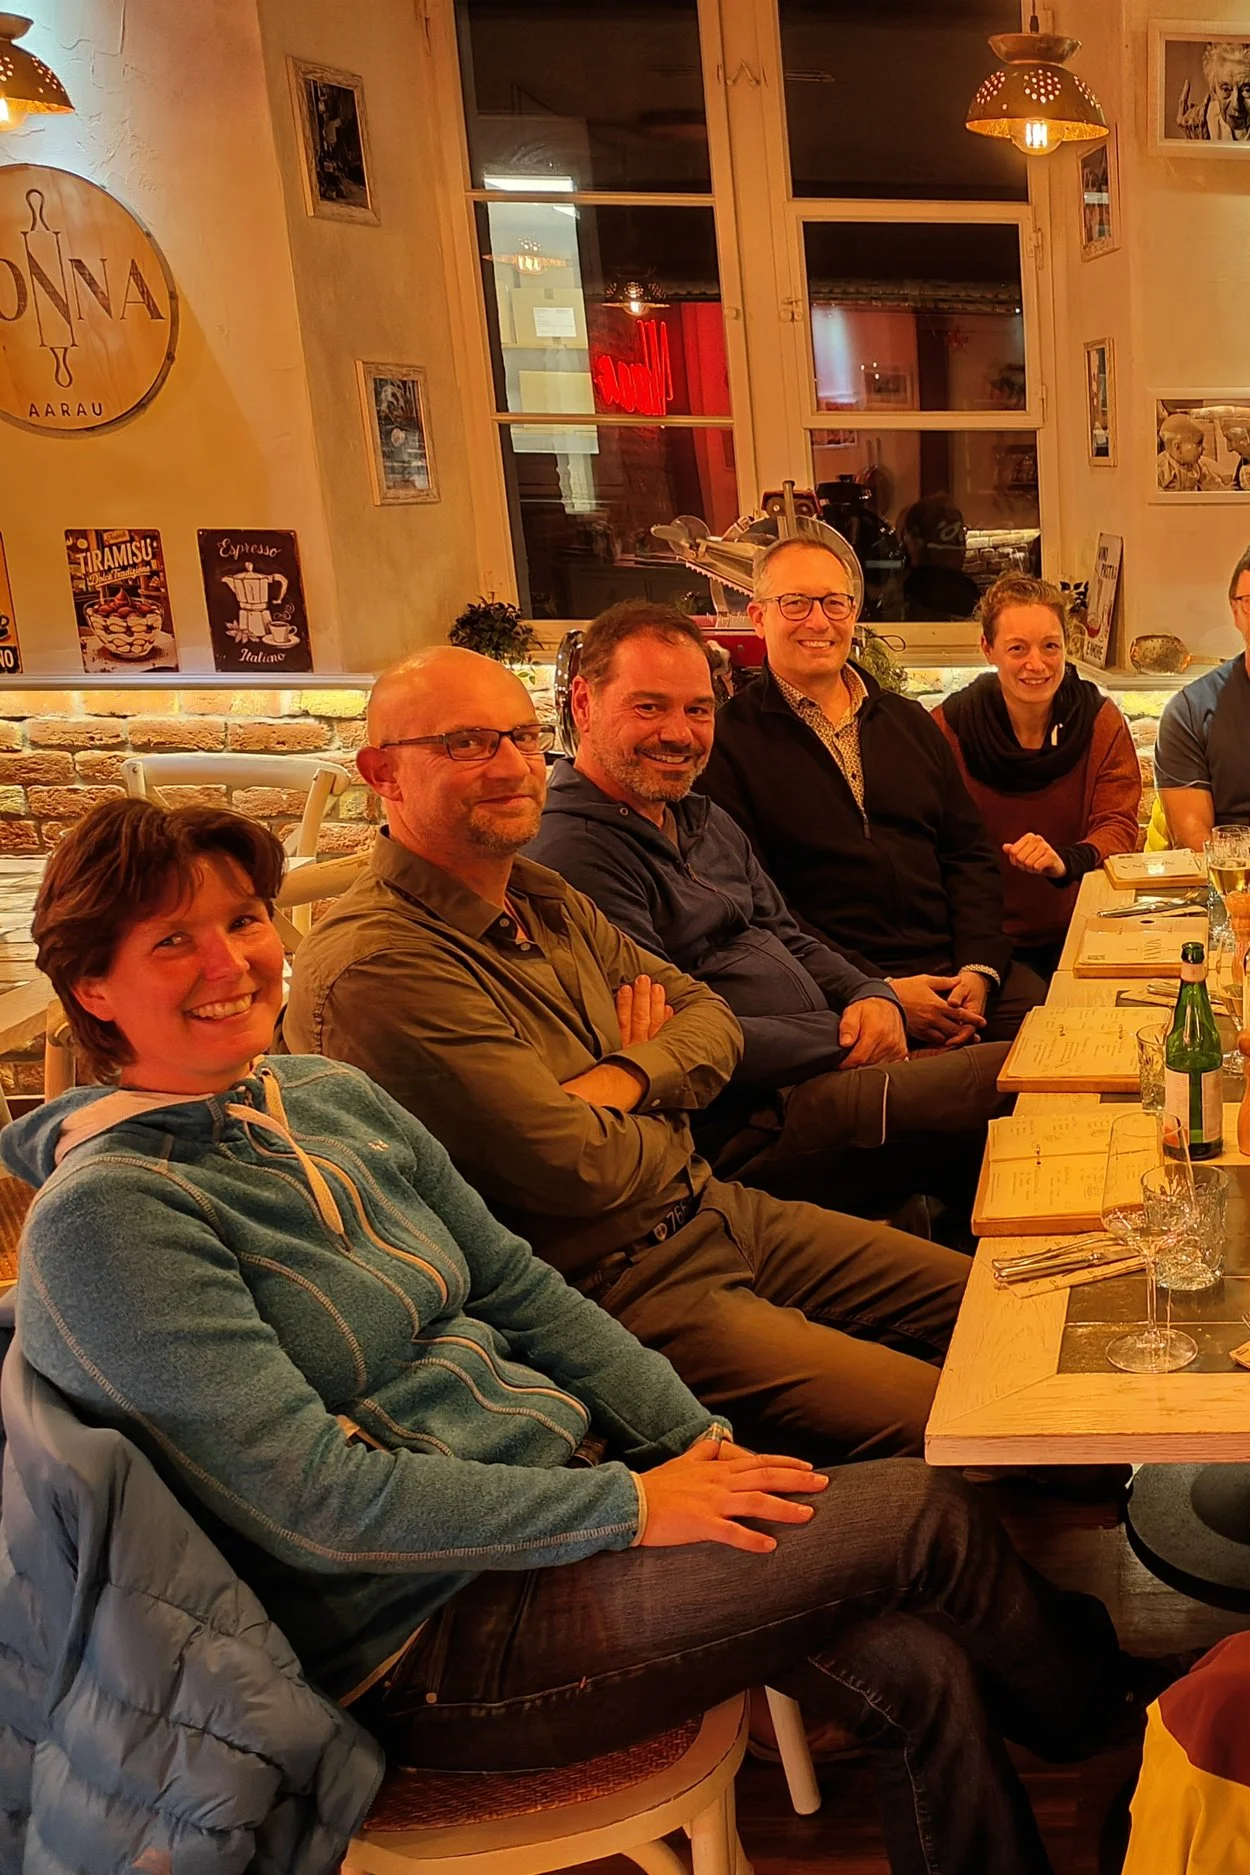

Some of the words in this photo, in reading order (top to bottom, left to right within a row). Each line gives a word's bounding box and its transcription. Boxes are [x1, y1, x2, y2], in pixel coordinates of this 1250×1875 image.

[29, 402, 103, 417] AARAU
[76, 538, 152, 574] TIRAMISU
[217, 538, 282, 560] Espresso
